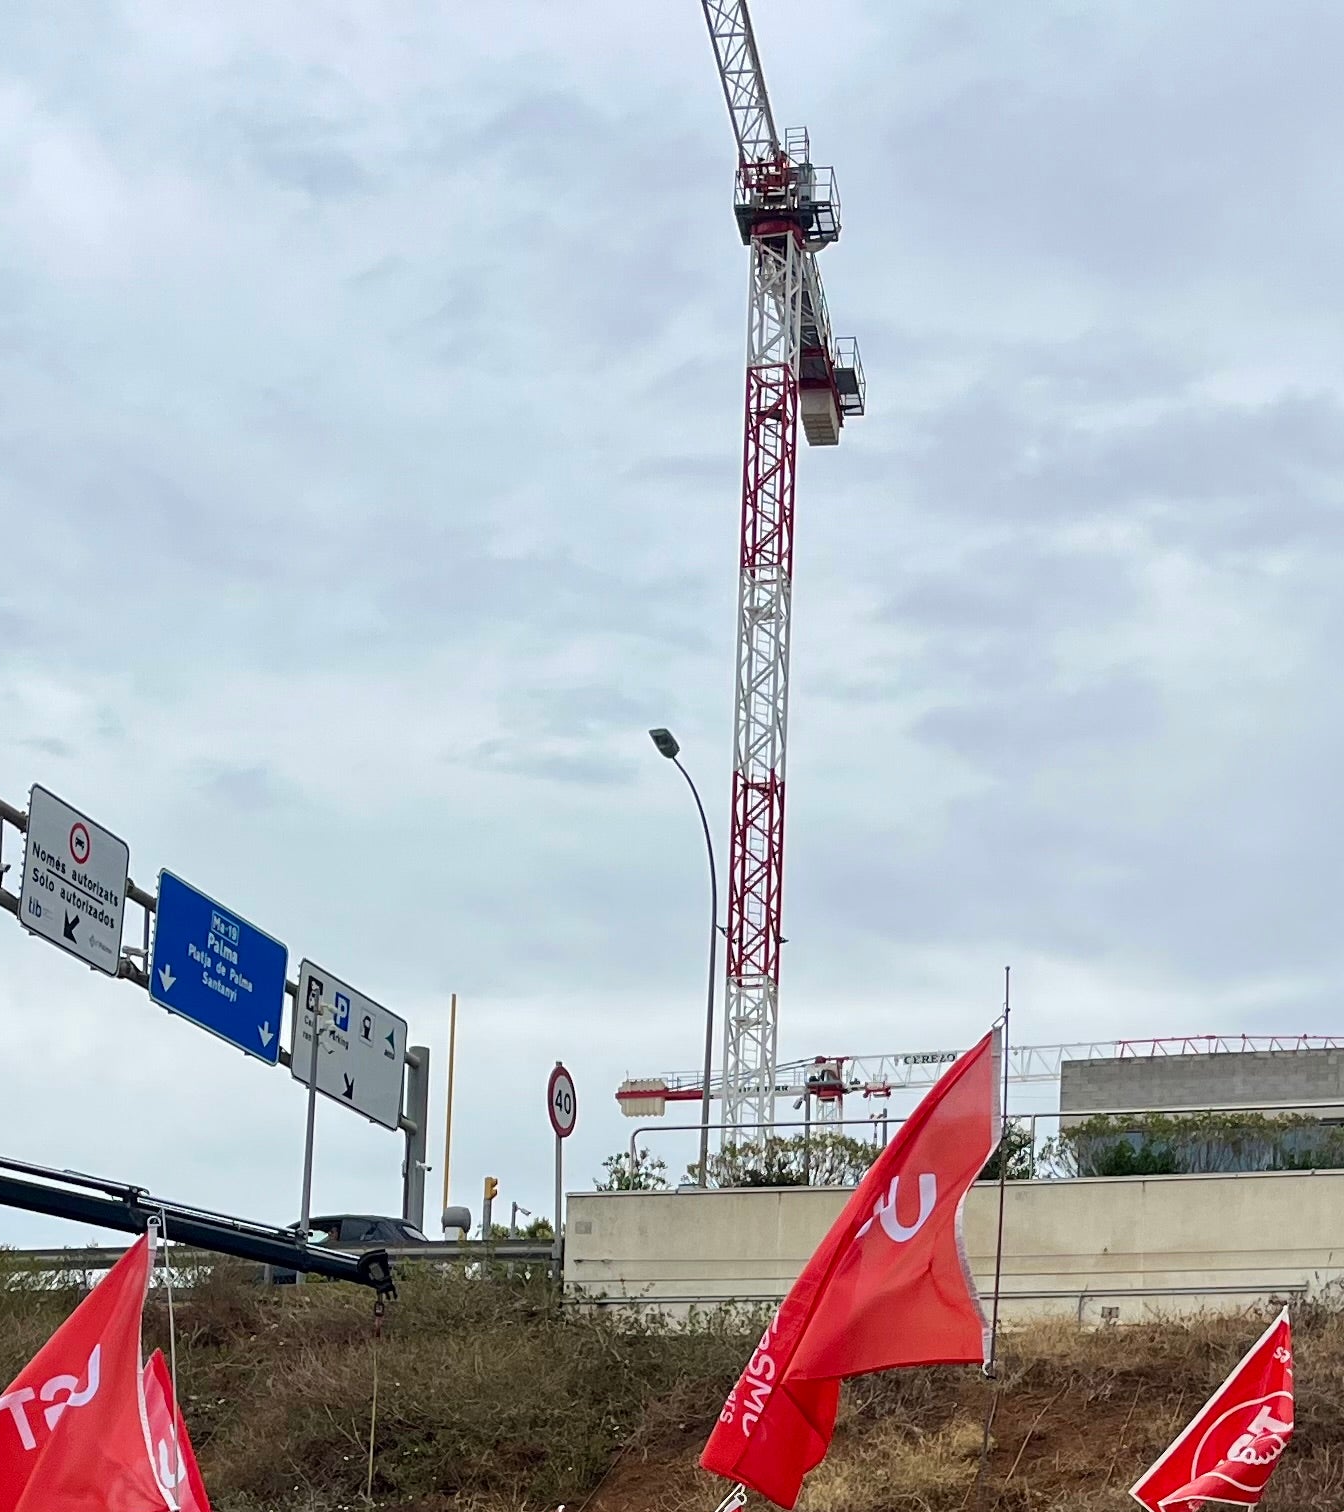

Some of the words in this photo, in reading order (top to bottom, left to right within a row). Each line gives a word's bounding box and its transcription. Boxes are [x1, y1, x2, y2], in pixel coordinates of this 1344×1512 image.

[32, 841, 66, 875] Només
[72, 868, 118, 907] autorizats
[32, 867, 54, 892] Sólo
[60, 886, 115, 929] autorizados
[207, 932, 238, 965] Palma
[212, 915, 237, 941] Ma-19
[188, 943, 212, 968] Platja
[216, 961, 226, 976] de
[229, 967, 253, 993] Palma
[555, 1089, 571, 1114] 40
